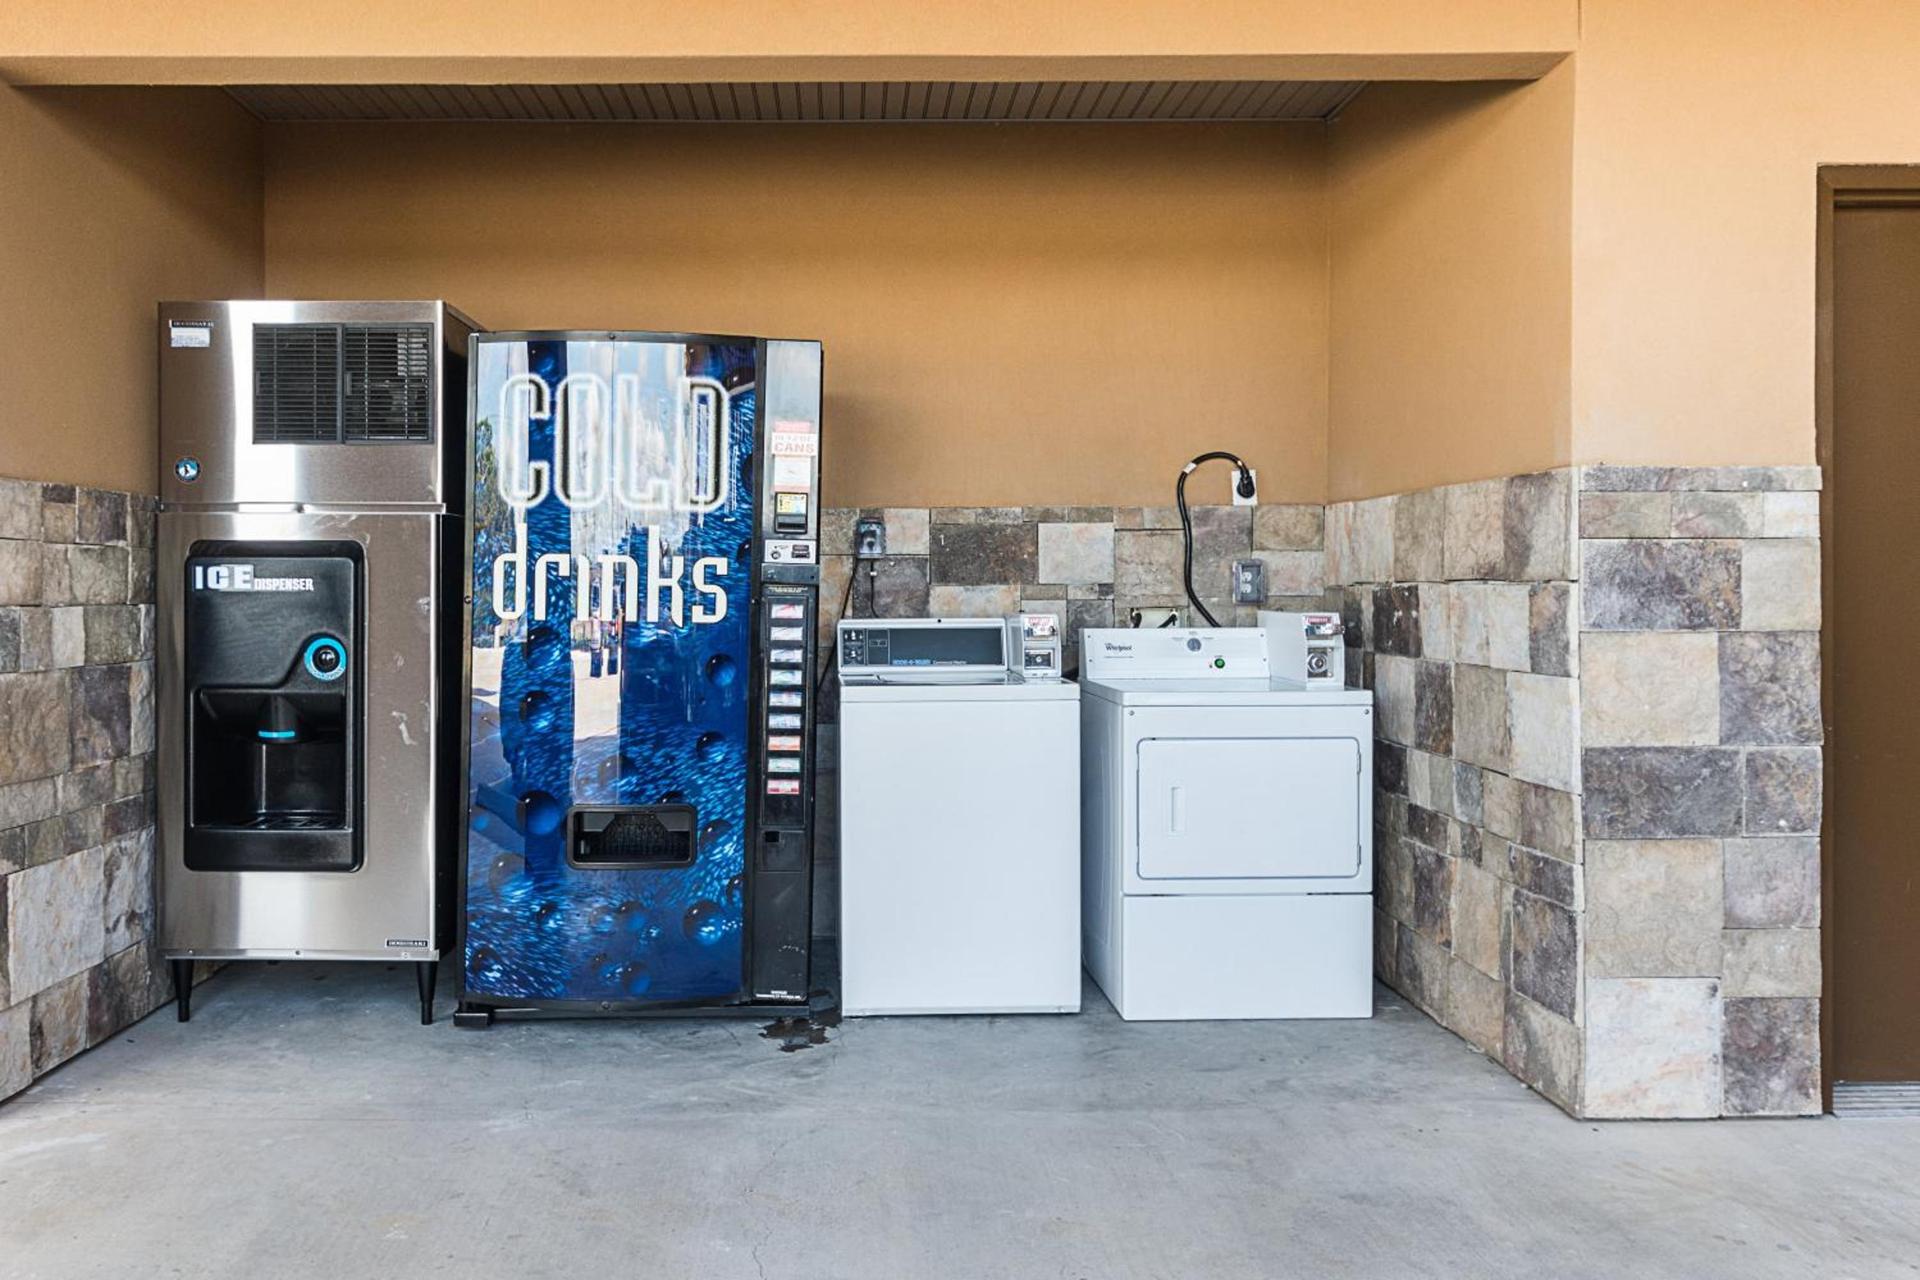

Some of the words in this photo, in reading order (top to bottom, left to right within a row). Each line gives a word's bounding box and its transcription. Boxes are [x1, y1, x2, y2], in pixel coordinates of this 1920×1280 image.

[499, 375, 730, 512] COLD
[774, 443, 814, 453] CANS
[195, 566, 252, 590] ICE
[254, 578, 314, 591] DISPENSER
[493, 523, 728, 627] drinks
